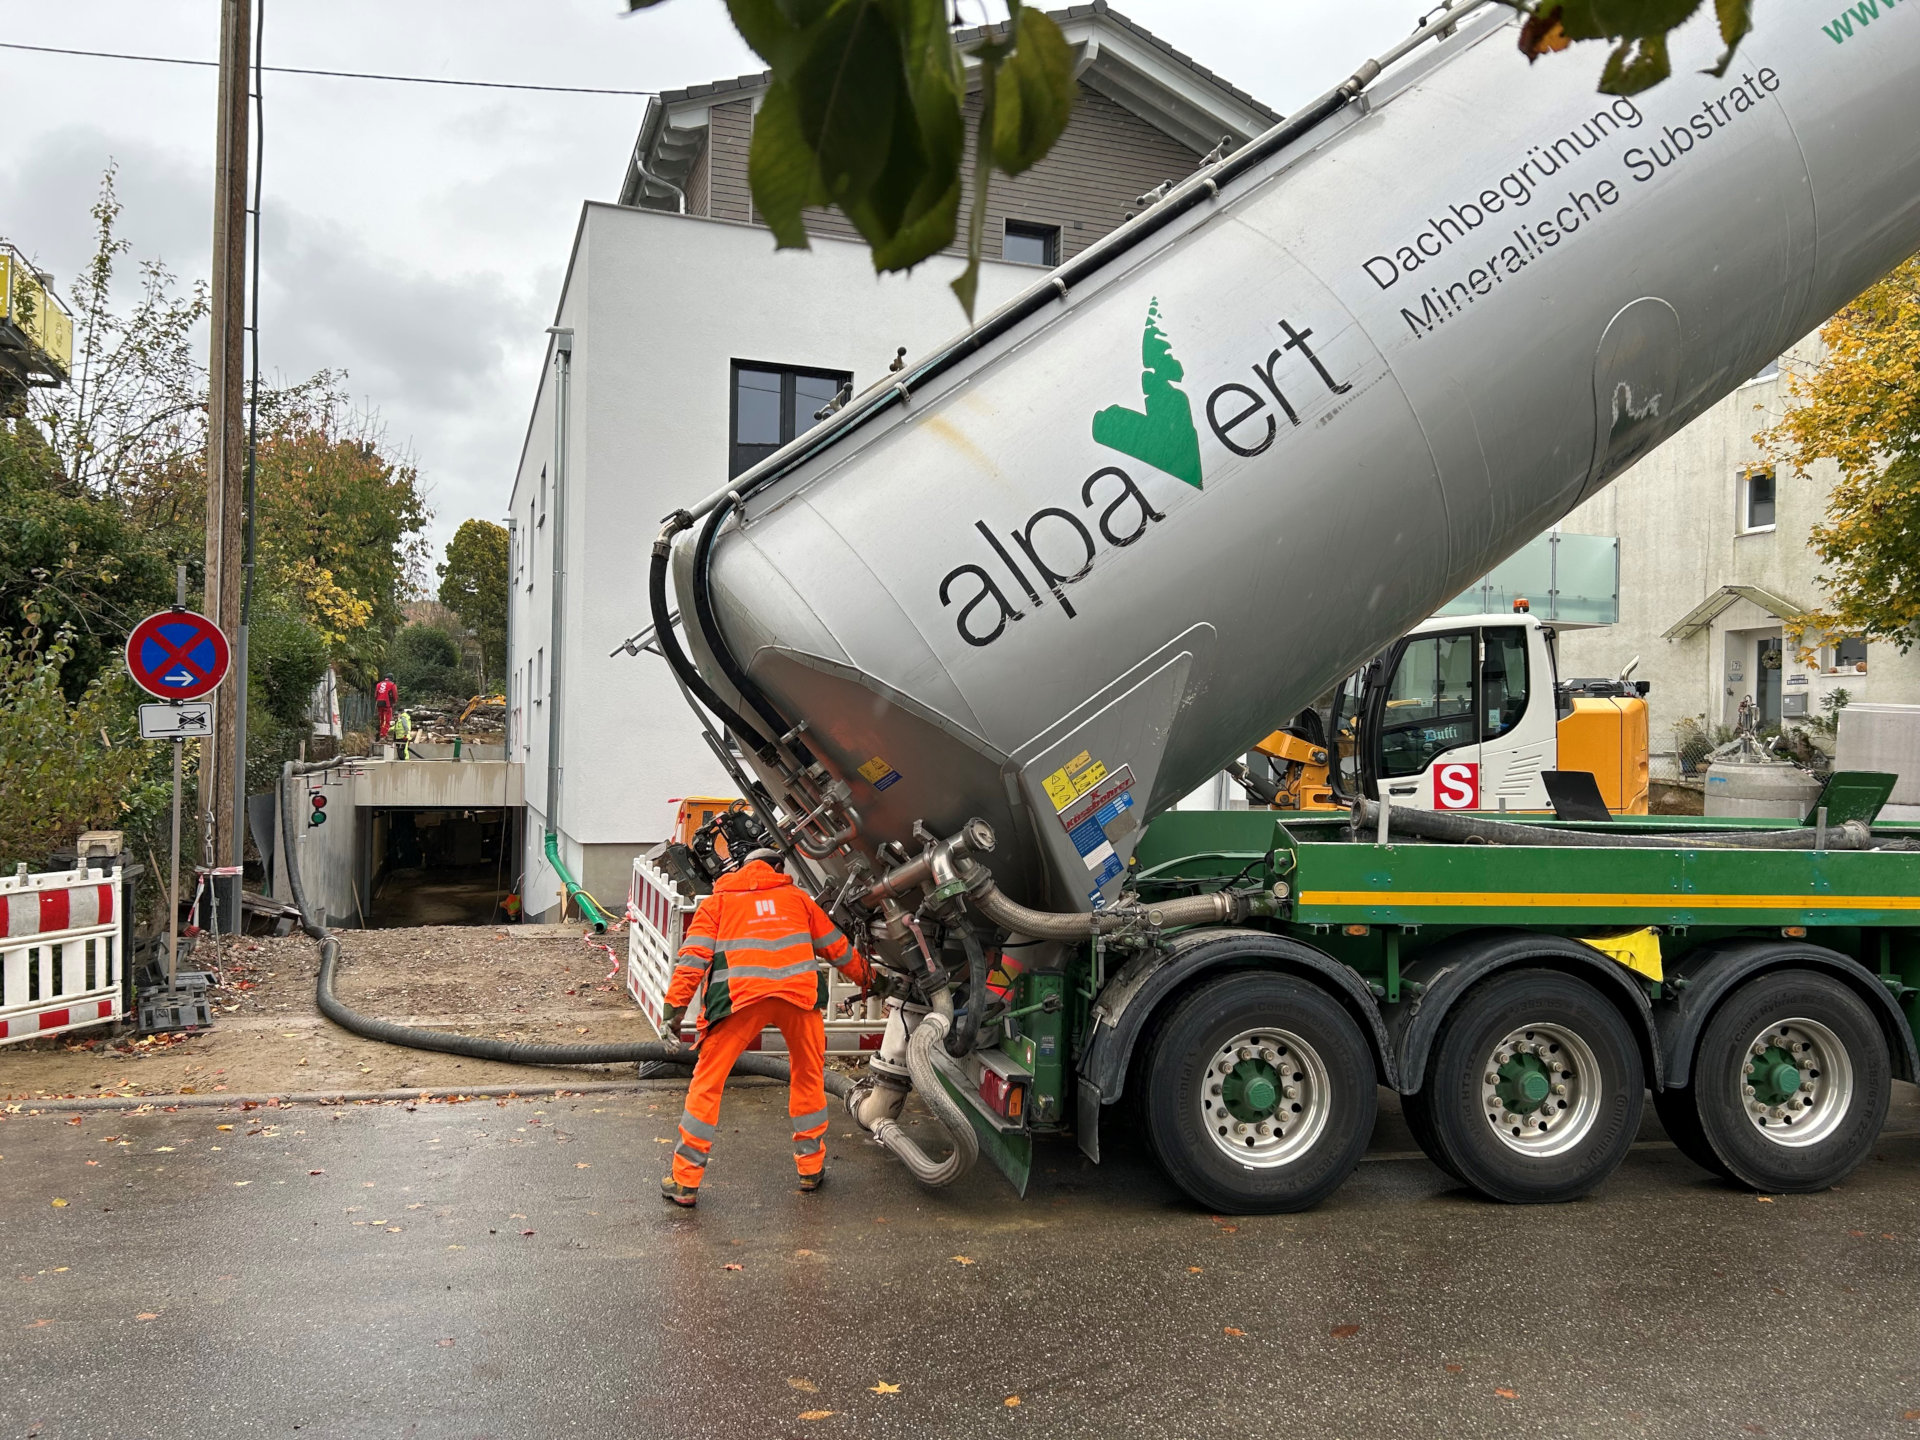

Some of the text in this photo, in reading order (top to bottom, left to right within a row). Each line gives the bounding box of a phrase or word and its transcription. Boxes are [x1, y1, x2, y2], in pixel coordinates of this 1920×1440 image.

[1362, 96, 1644, 290] Dachbegrünung
[1400, 66, 1781, 339] Mineralische Substrate
[1439, 764, 1474, 808] S
